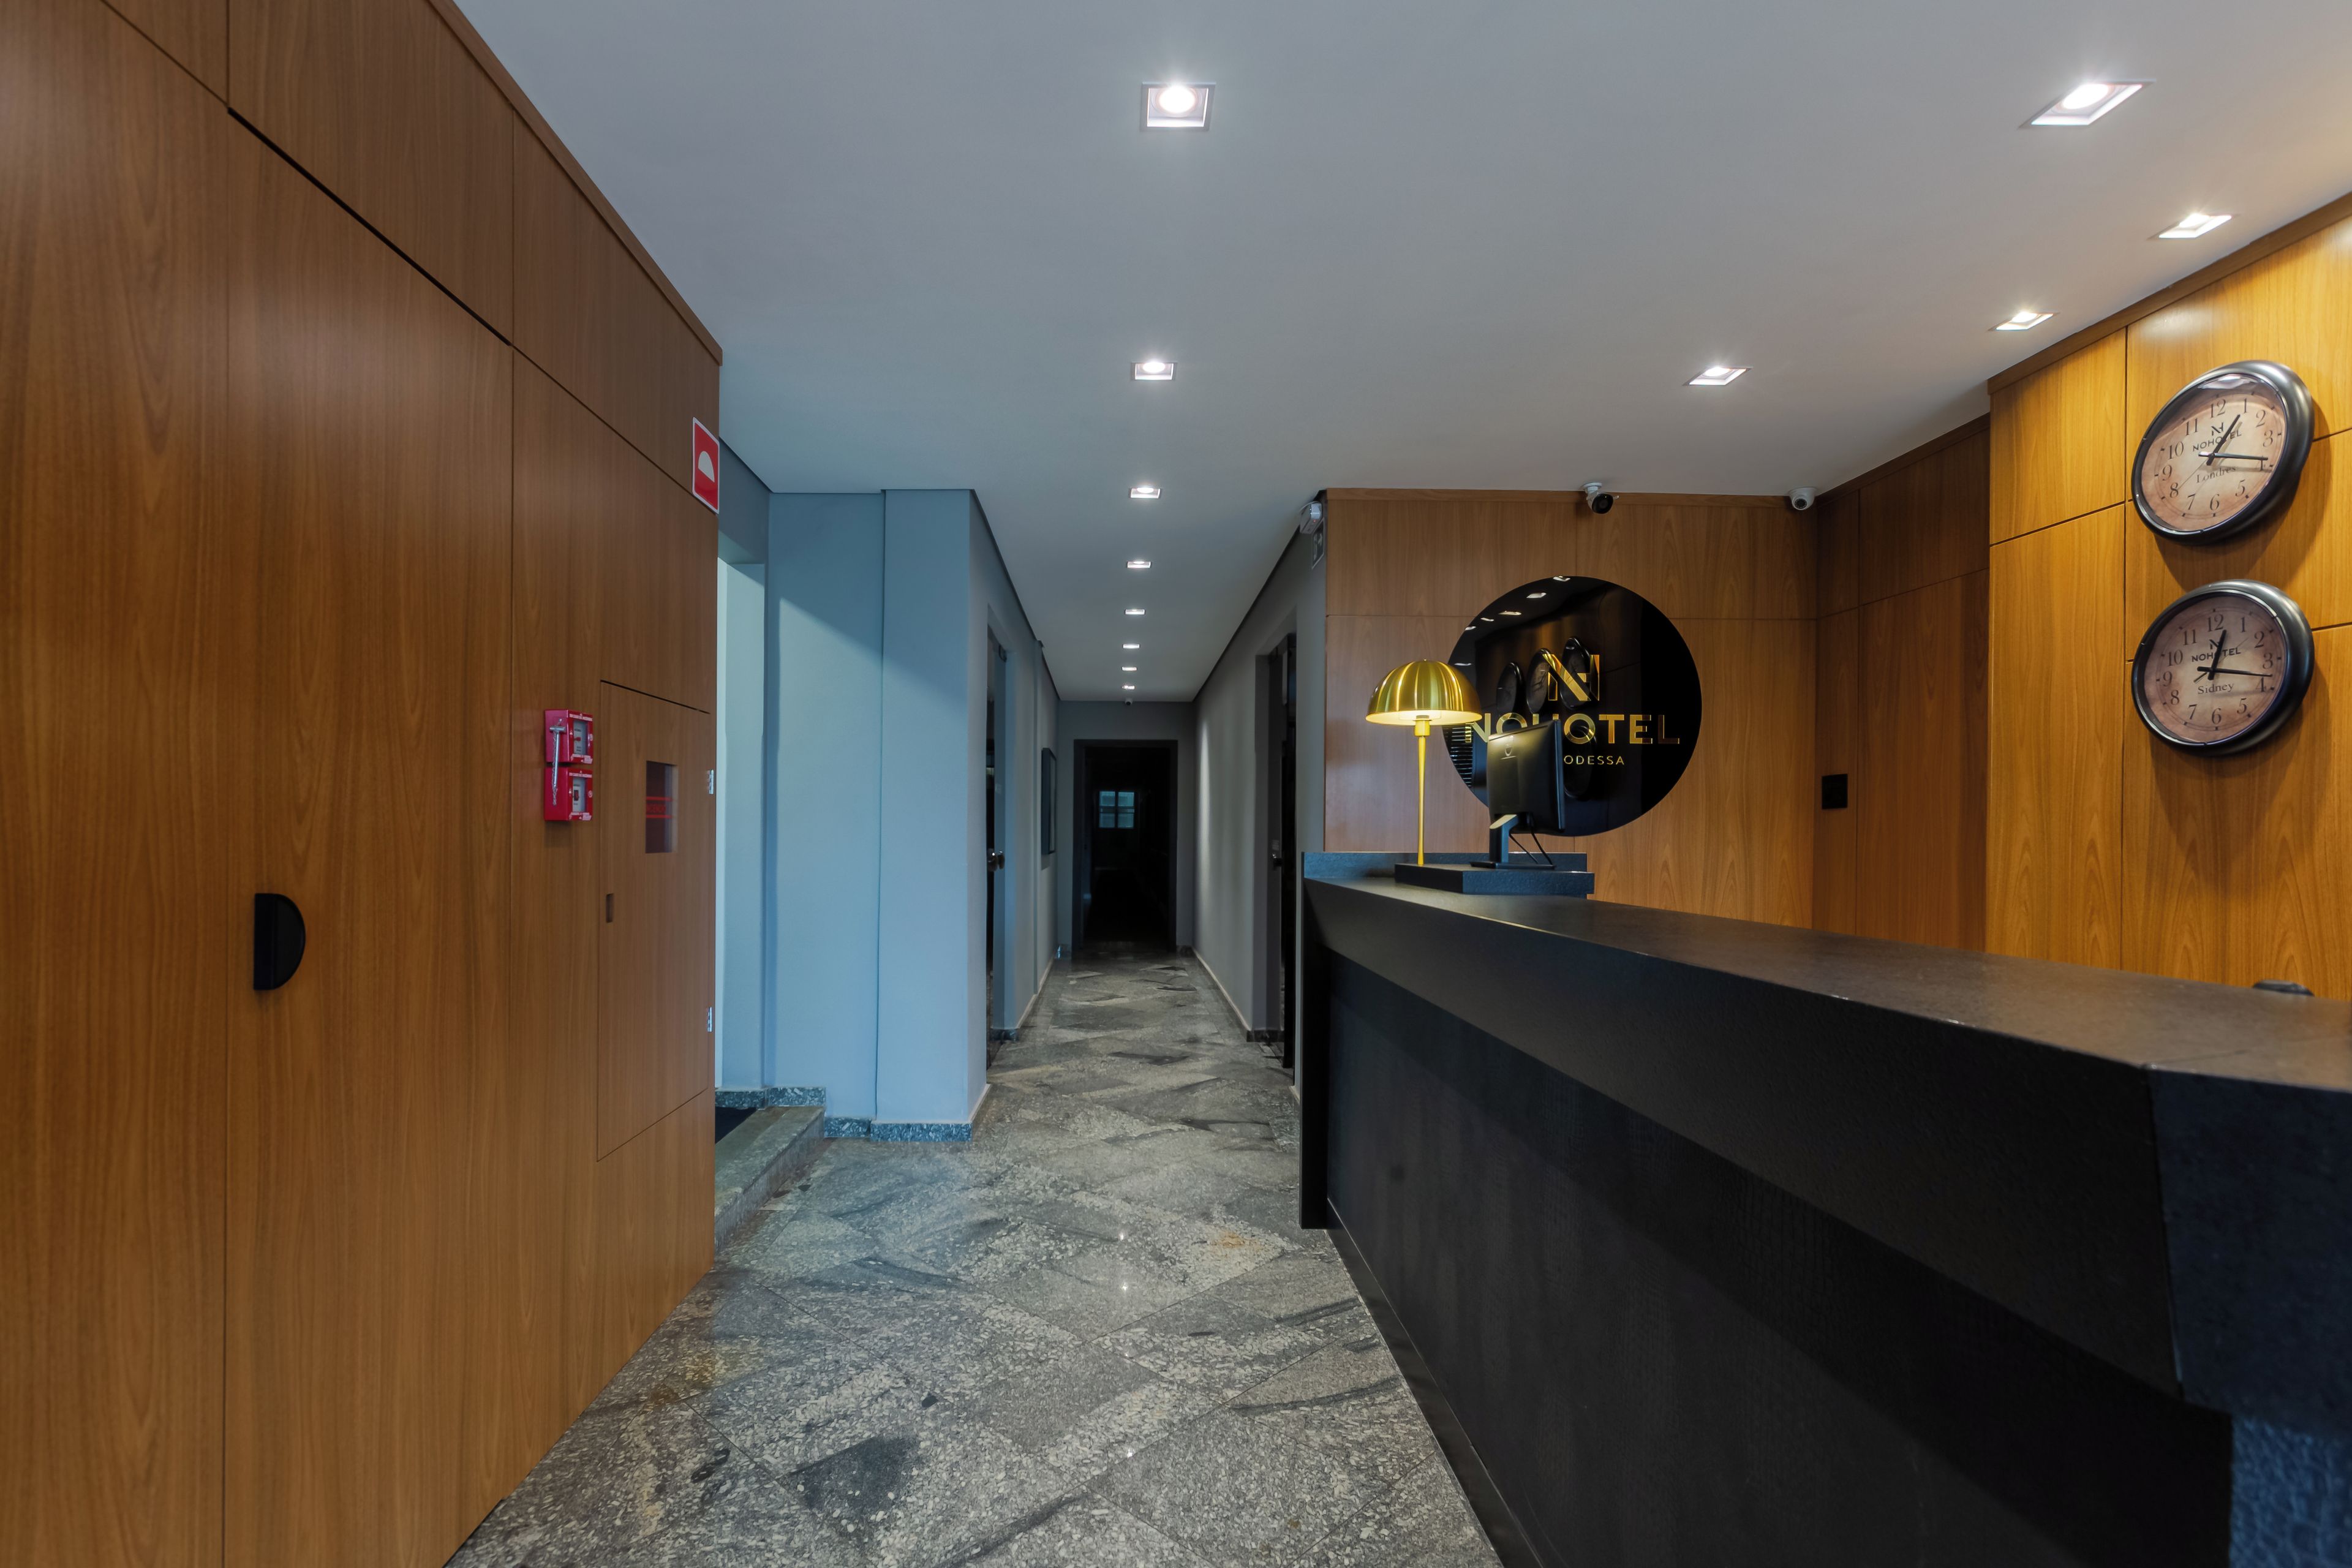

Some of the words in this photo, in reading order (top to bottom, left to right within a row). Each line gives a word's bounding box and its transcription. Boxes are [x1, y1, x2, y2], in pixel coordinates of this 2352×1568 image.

[2210, 399, 2226, 419] 12
[2244, 398, 2248, 414] 1
[2185, 418, 2198, 436] 11
[2256, 409, 2266, 428] 2
[2193, 429, 2242, 452] NOHOEL
[2263, 430, 2273, 447] 3
[2168, 441, 2185, 459] 10
[2162, 464, 2173, 481] 9
[2196, 467, 2236, 483] Londres
[2169, 482, 2179, 498] 8
[2235, 479, 2246, 497] 5
[2187, 494, 2196, 510] 7
[2209, 494, 2220, 511] 6
[2207, 614, 2224, 632] 12
[2241, 617, 2246, 633] 1
[2182, 629, 2197, 646] 11
[2254, 631, 2264, 649] 2
[2167, 649, 2183, 666] 10
[2192, 647, 2241, 662] NOHTEL
[2263, 652, 2273, 669] 3
[2162, 671, 2173, 687] 9
[2255, 676, 2266, 692] 4
[2198, 683, 2234, 695] Sidney
[2170, 690, 2180, 706] 8
[2237, 698, 2247, 714] 5
[2188, 704, 2198, 720] 7
[2212, 707, 2222, 724] 6
[1563, 755, 1625, 766] ODESSA
